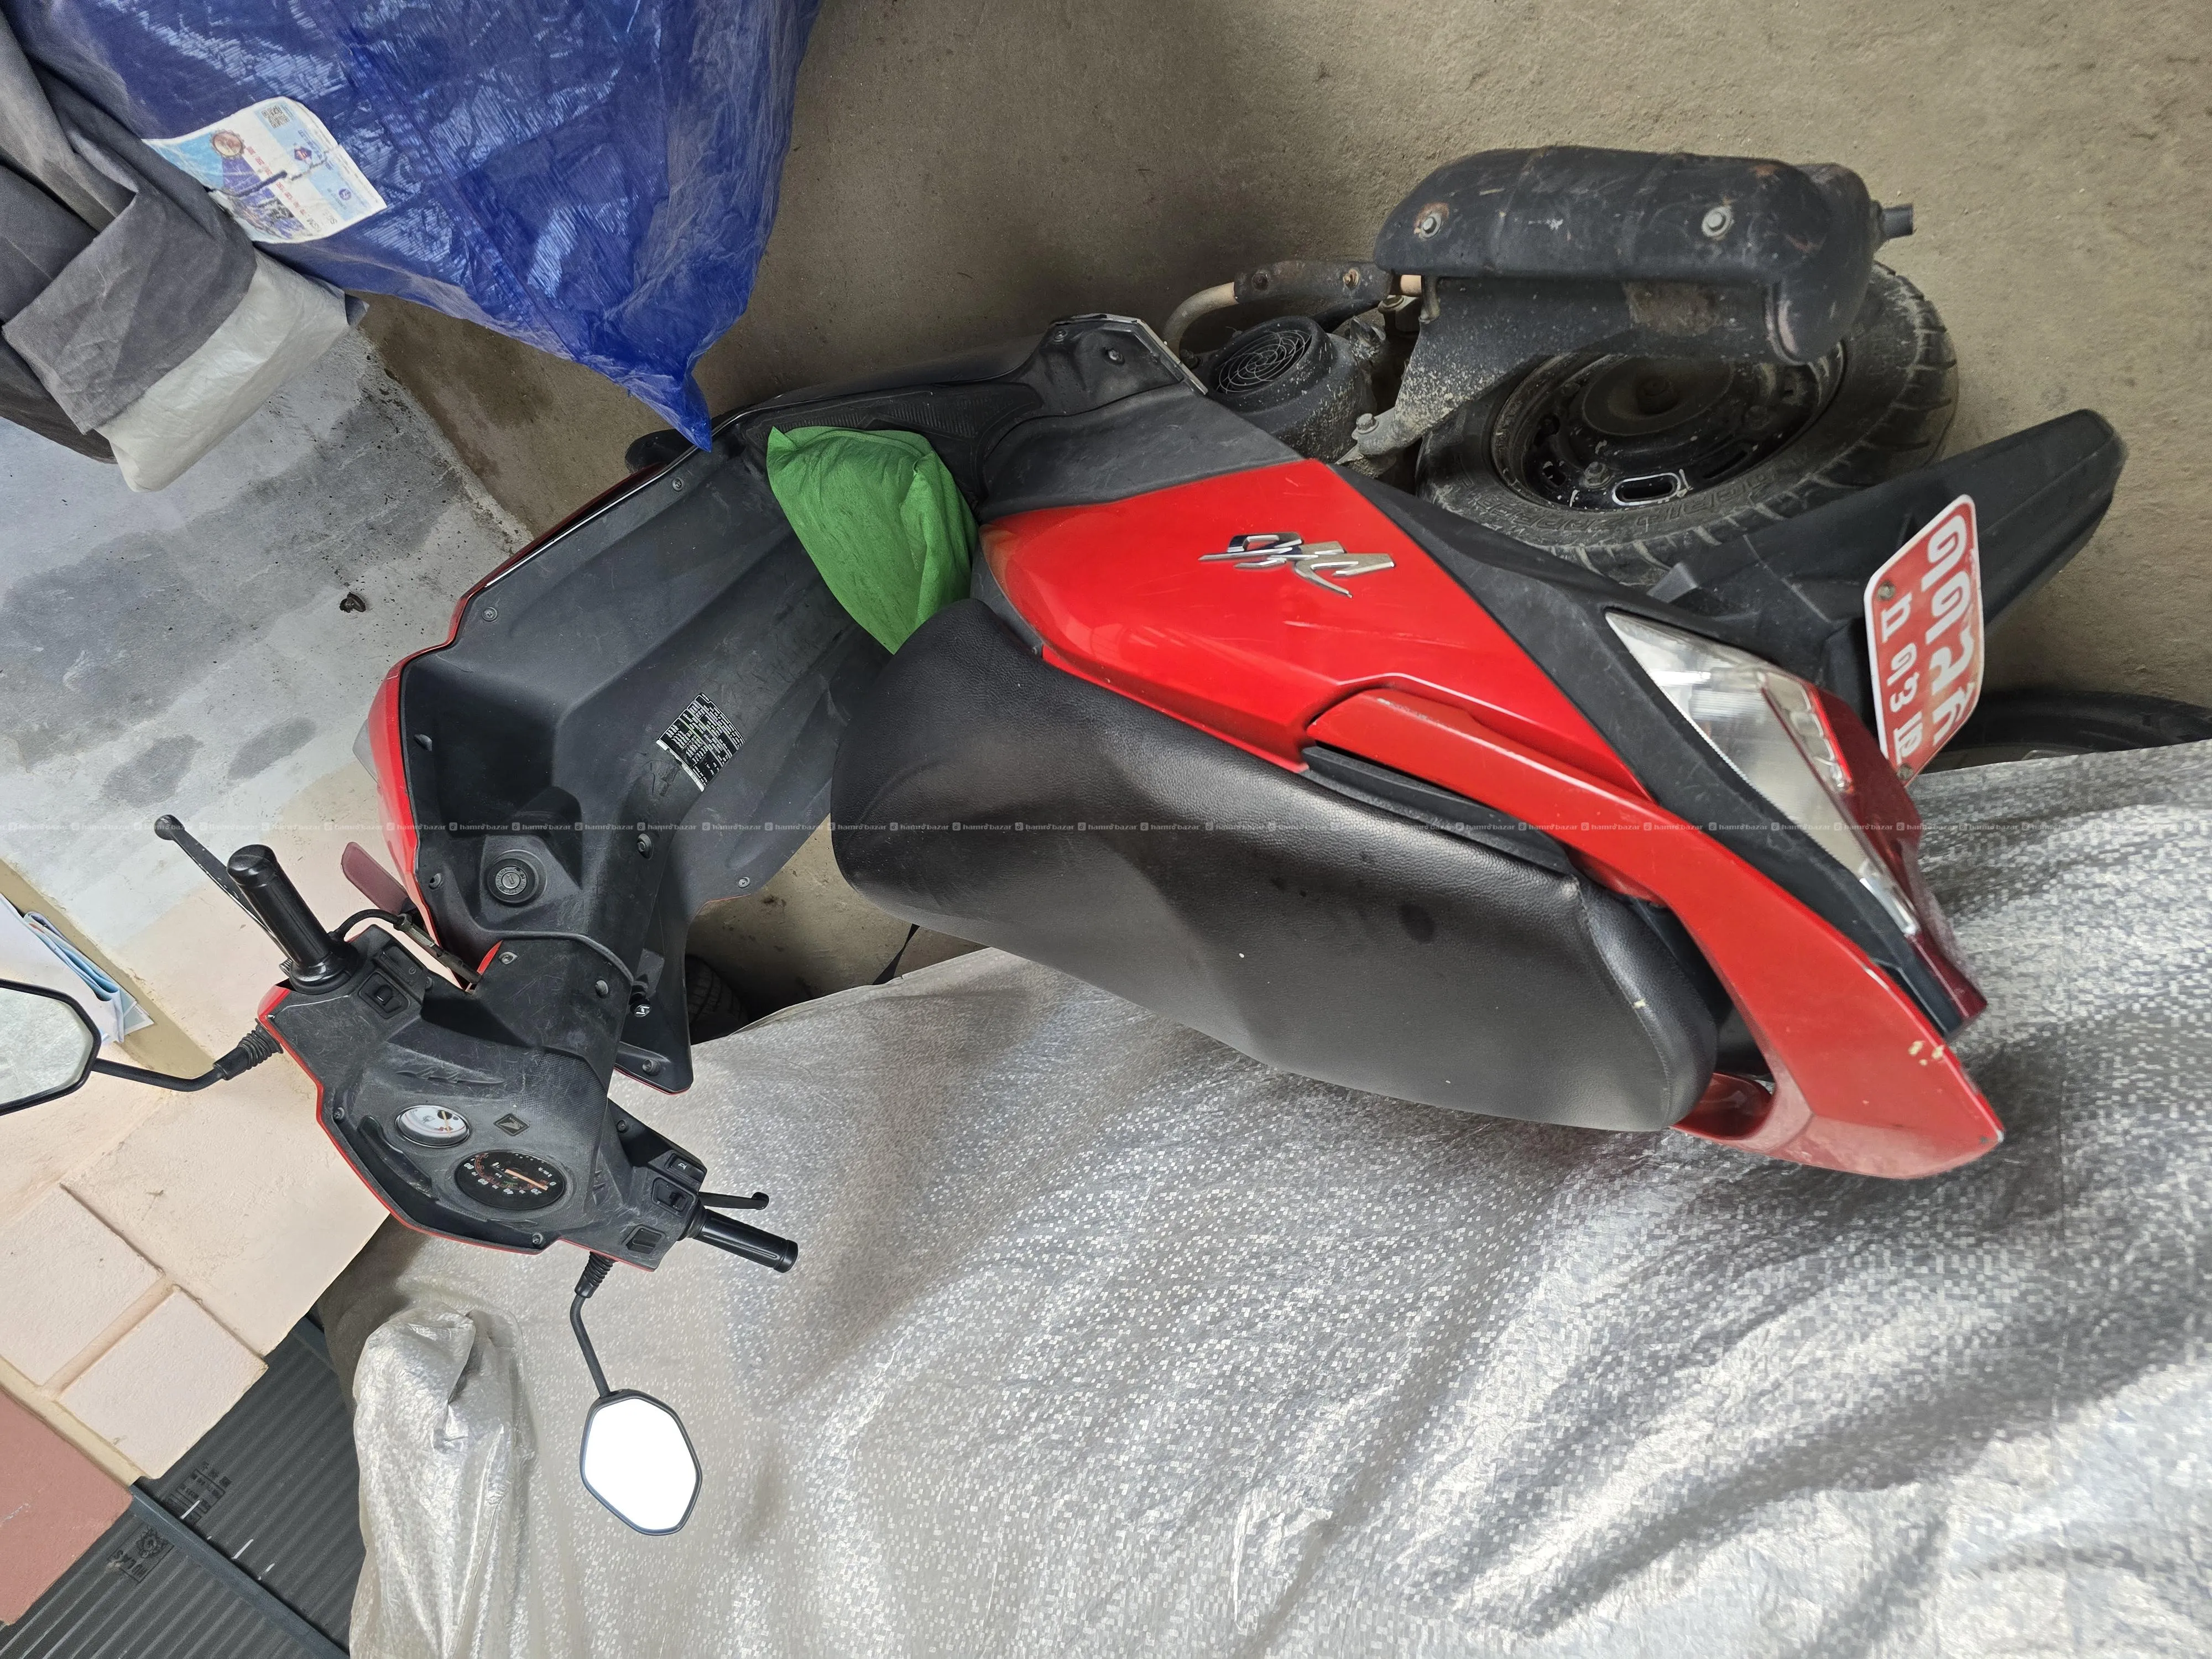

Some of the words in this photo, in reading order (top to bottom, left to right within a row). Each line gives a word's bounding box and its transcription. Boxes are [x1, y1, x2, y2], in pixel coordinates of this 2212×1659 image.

[1881, 592, 1913, 643] प
[1886, 642, 1920, 713] ६७
[1893, 711, 1923, 765] बा
